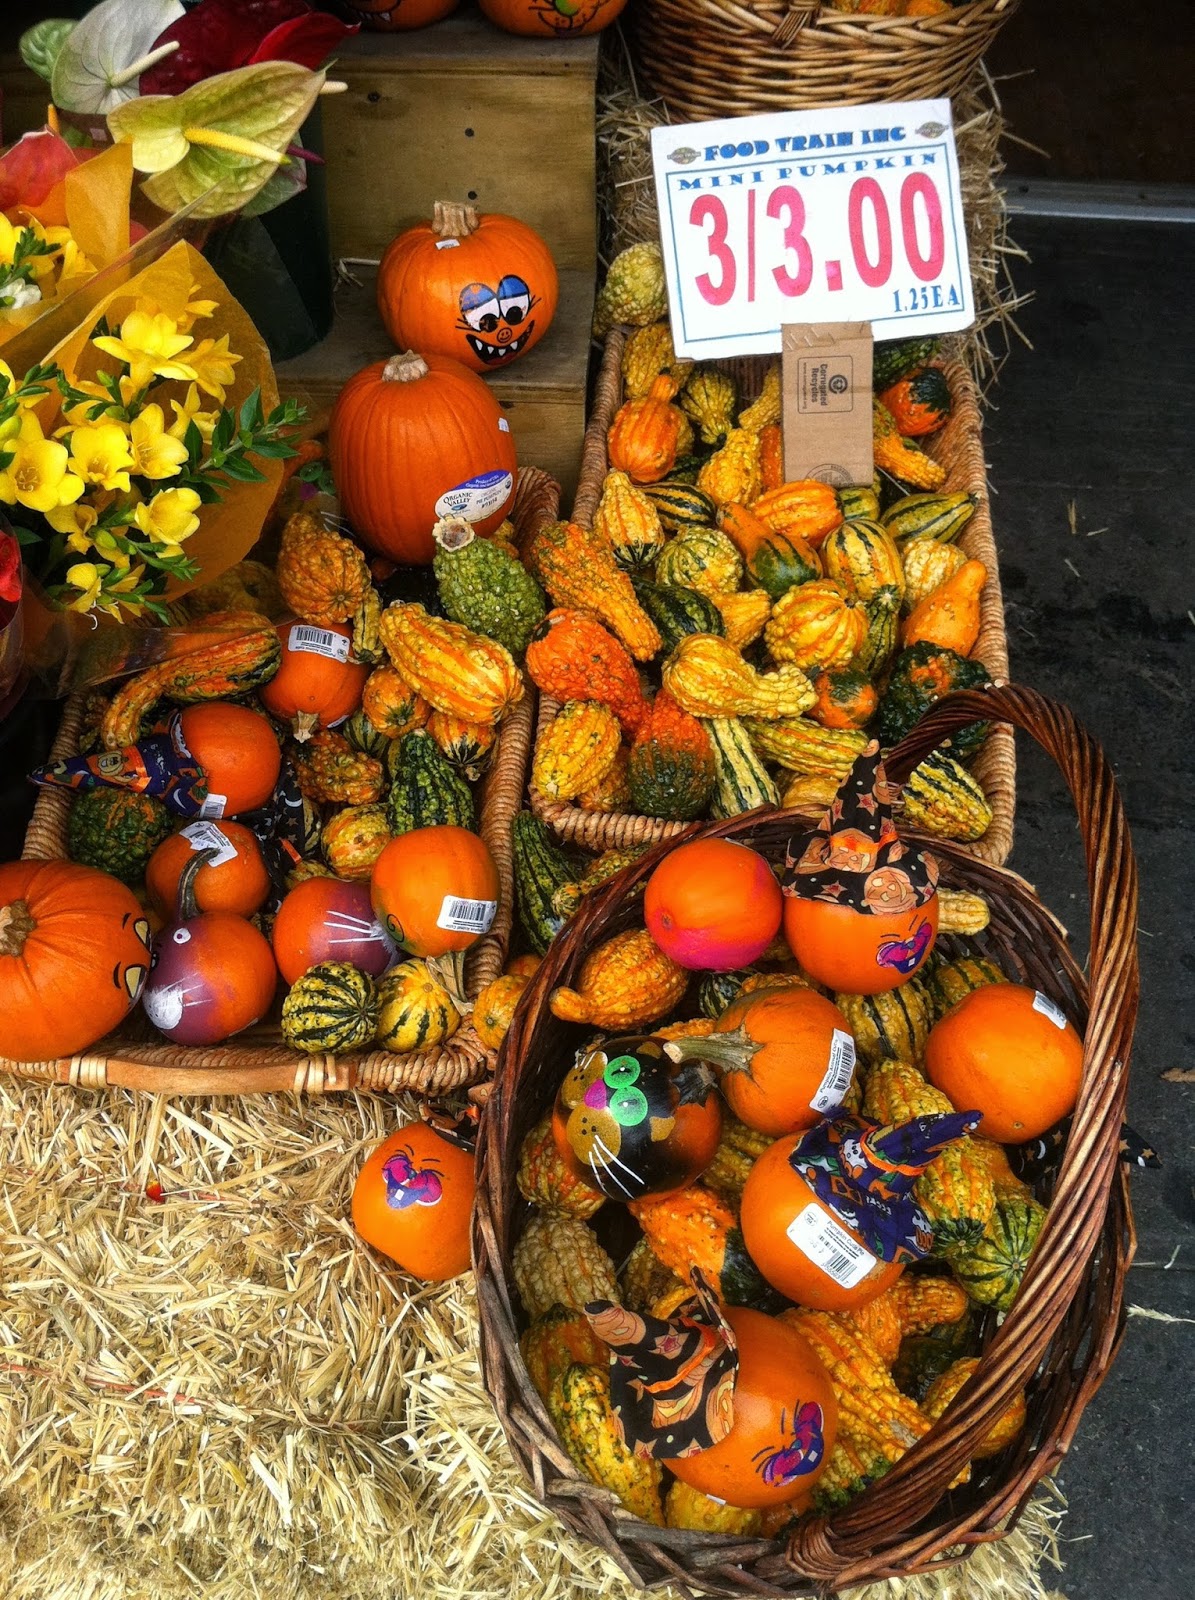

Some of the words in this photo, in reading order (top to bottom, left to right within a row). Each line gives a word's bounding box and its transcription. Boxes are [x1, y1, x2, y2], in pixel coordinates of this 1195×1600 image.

[704, 140, 770, 162] FOOD
[775, 131, 854, 153] TRAIN
[861, 126, 906, 145] INC
[678, 170, 765, 191] MINI
[776, 152, 937, 180] PUMPKIN
[689, 171, 945, 306] 3/3.00
[810, 367, 819, 403] Recycles
[820, 363, 828, 407] Corrugated
[443, 492, 473, 505] ORGANIC
[447, 497, 471, 507] VALLEY
[826, 1220, 847, 1241] Pumpkin
[856, 1247, 865, 1256] Pie
